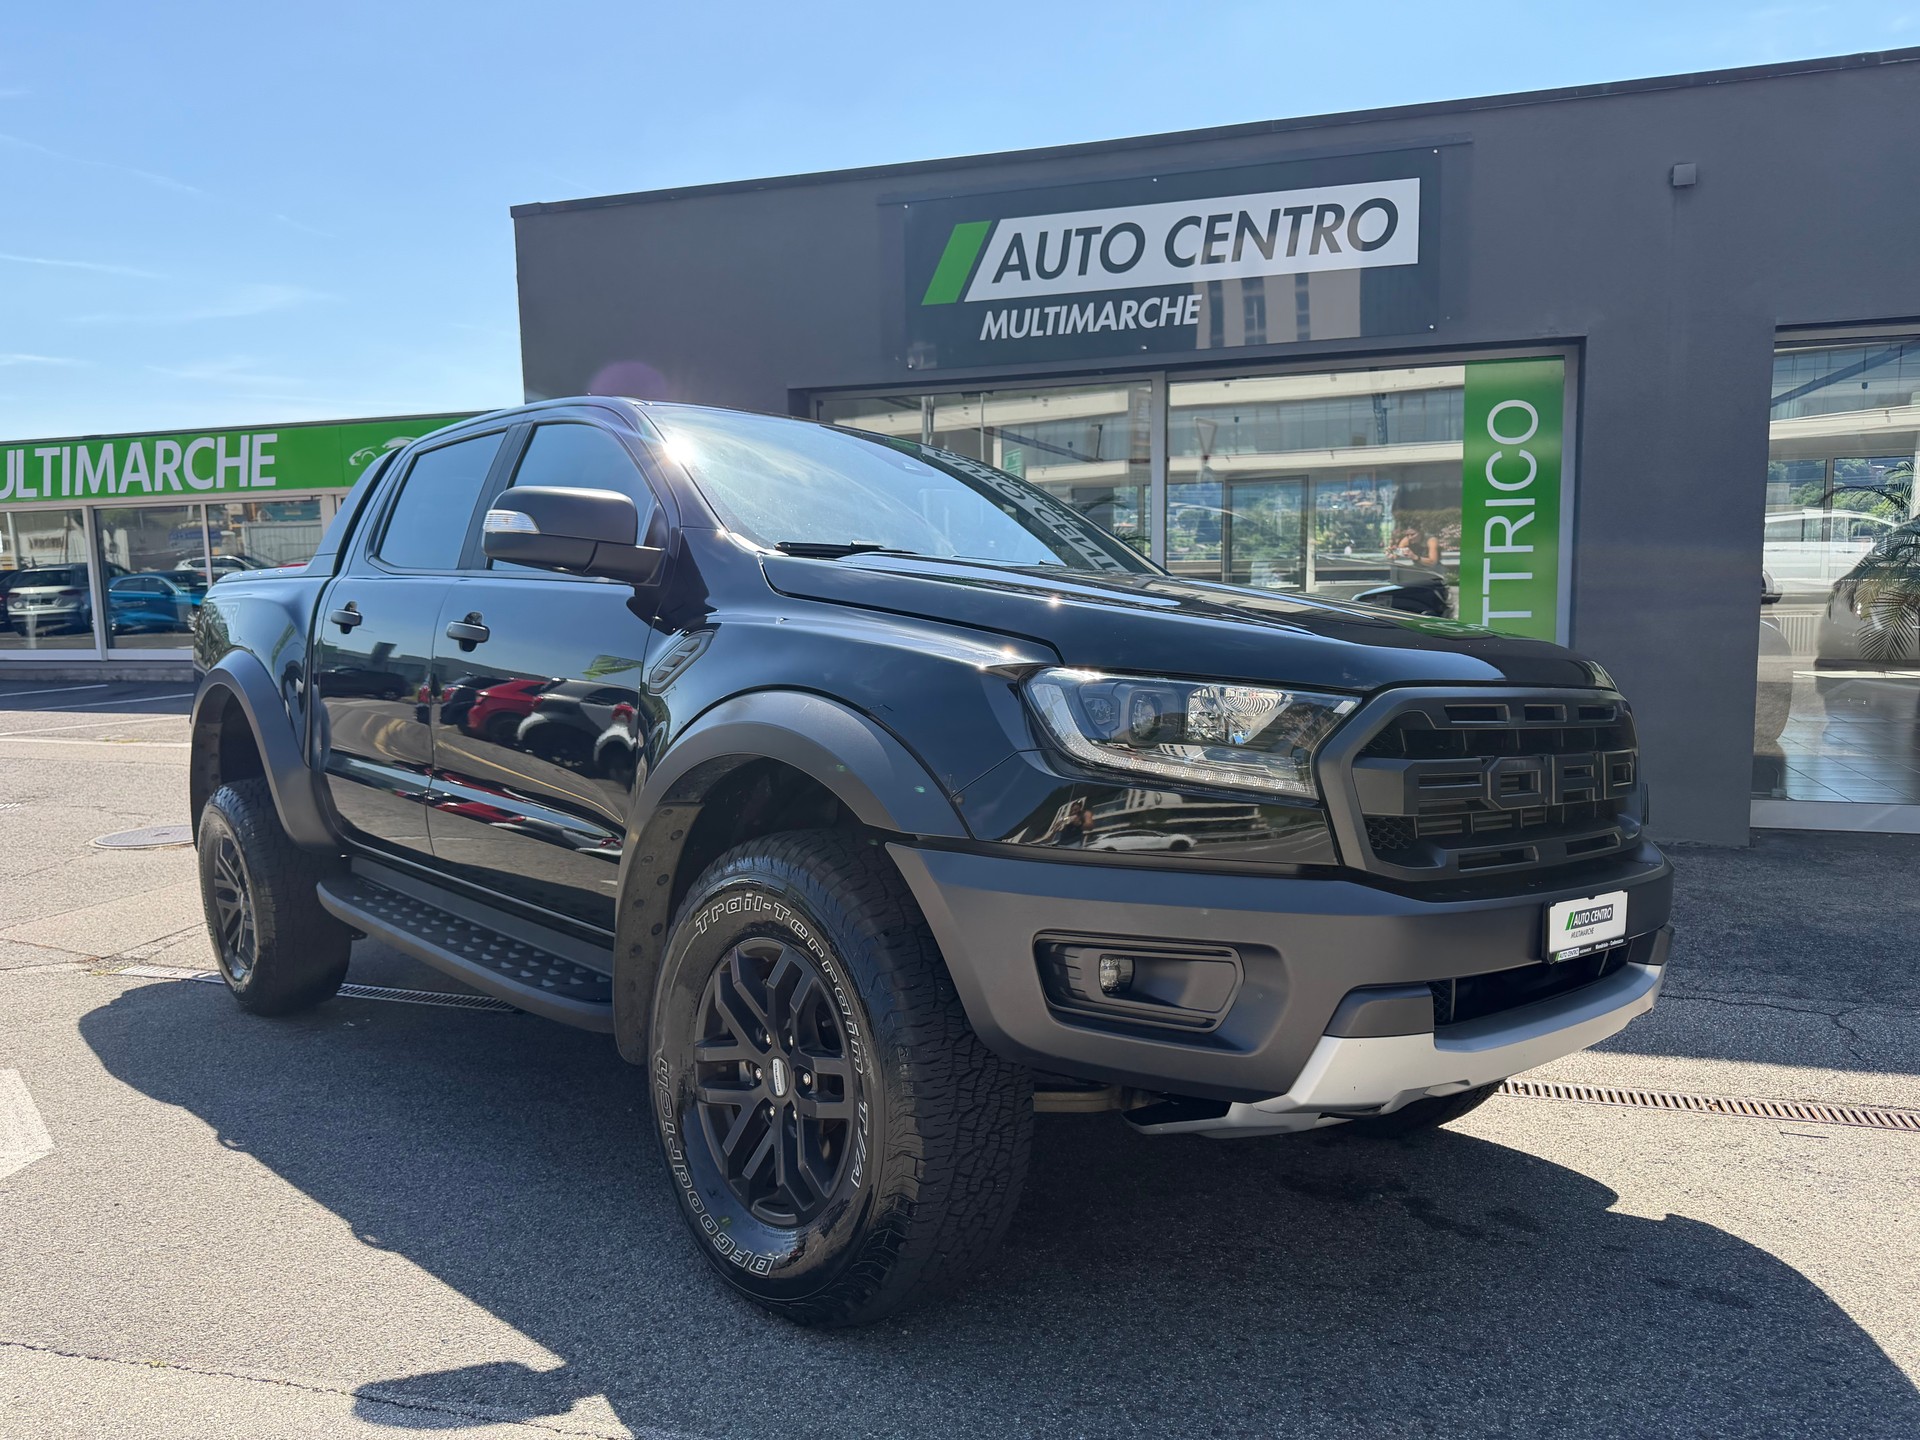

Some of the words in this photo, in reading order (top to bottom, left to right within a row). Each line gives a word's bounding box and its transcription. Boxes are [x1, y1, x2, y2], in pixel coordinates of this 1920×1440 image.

[991, 221, 1146, 284] AUTO
[1164, 197, 1400, 268] CENTRO
[979, 294, 1203, 341] MULTIMARCHE
[1481, 399, 1539, 627] TTRICO
[1573, 912, 1590, 925] AUTO
[1590, 907, 1612, 922] CENTRO
[695, 892, 865, 1075] Trail-Terrain
[656, 1057, 775, 1276] BFGoodrich
[850, 1101, 869, 1189] T/A
